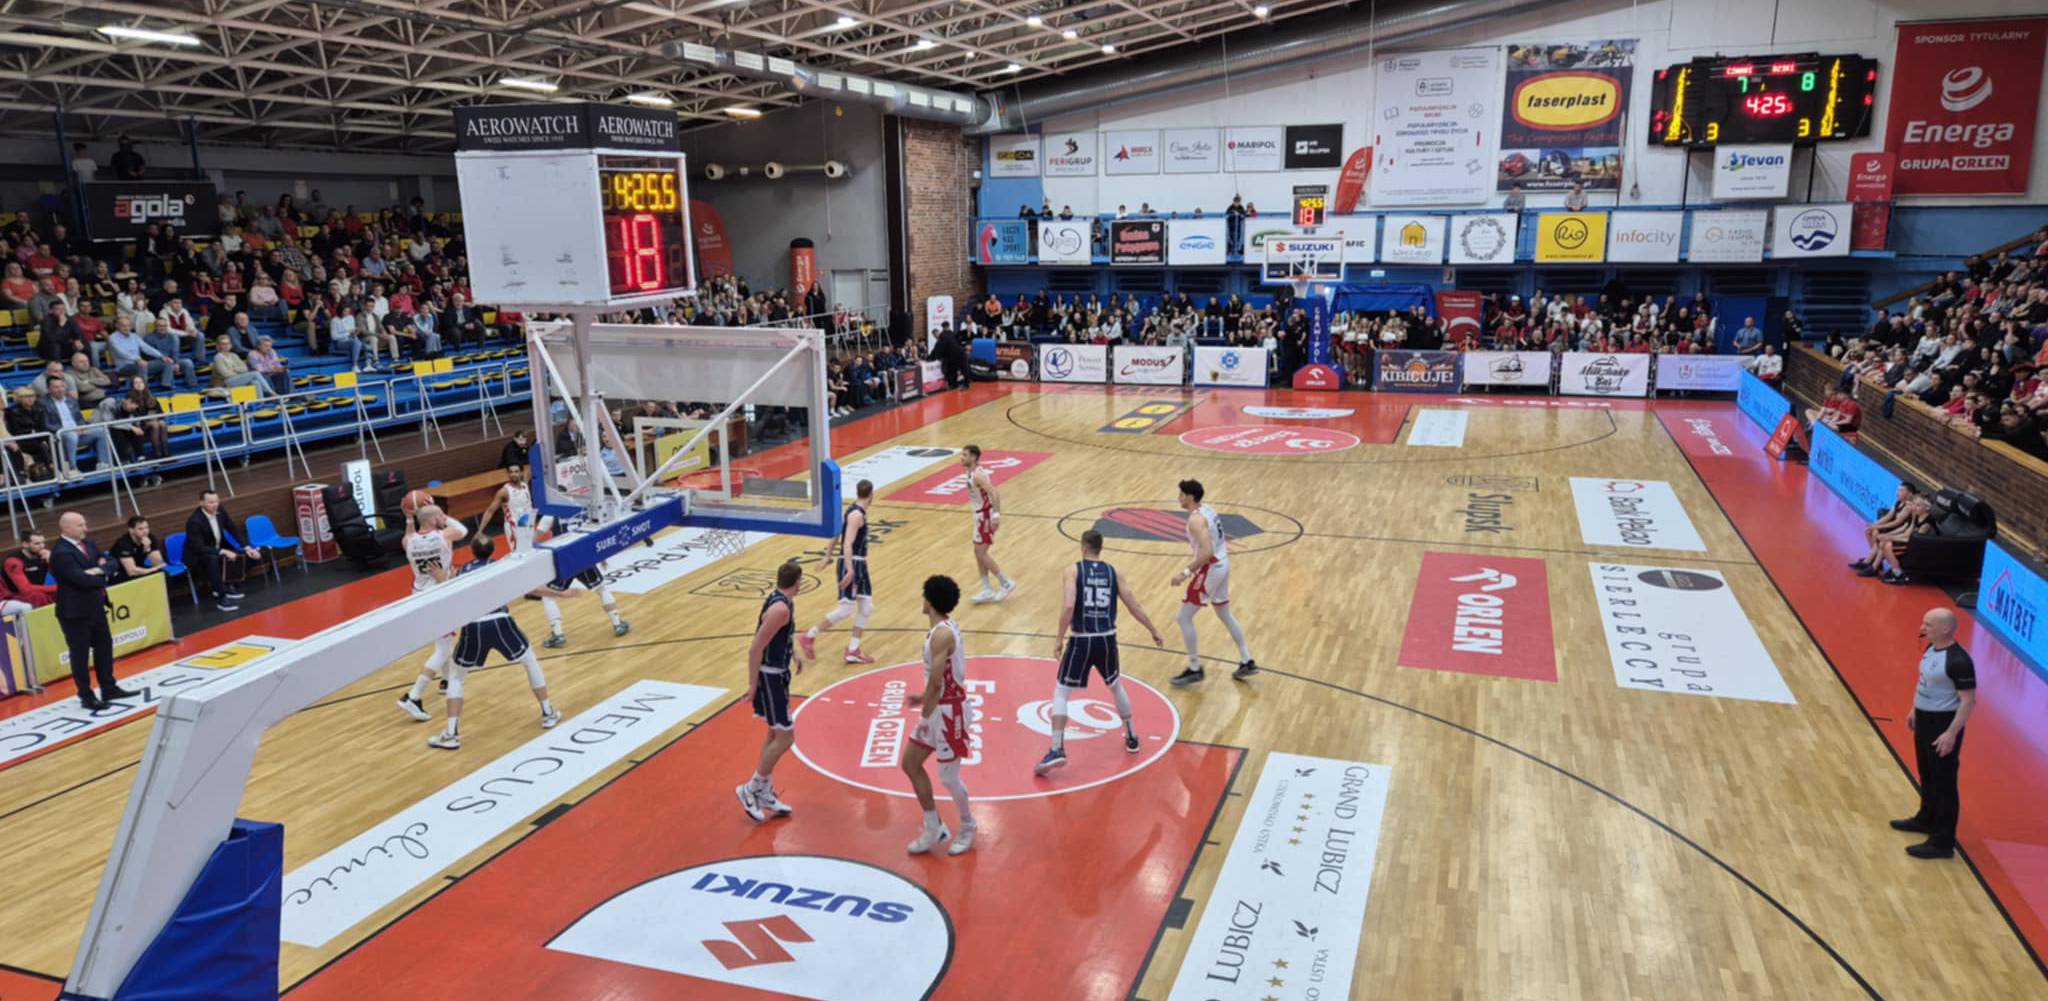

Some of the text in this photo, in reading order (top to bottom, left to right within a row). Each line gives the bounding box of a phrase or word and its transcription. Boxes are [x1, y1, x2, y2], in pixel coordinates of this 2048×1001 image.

[1915, 31, 2030, 44] SPONSOR TYTULARNY
[1737, 76, 1748, 93] 7
[1801, 71, 1815, 91] 8
[1527, 94, 1607, 108] faserplast
[466, 115, 580, 136] AEROWATCH
[598, 116, 673, 138] AEROWATCH
[1706, 122, 1719, 141] 3
[1797, 117, 1810, 137] 3
[1904, 120, 2015, 148] Energa
[1740, 154, 1784, 166] Tevan
[1901, 157, 2006, 170] GRUPA ORLEN
[114, 194, 184, 223] agola
[1289, 242, 1334, 251] SUZUKI
[1616, 228, 1676, 246] infocity
[620, 213, 662, 291] 18
[1131, 358, 1168, 367] MODUS
[1381, 370, 1454, 383] KIBICUJE!
[1608, 496, 1650, 519] Bank
[1616, 517, 1658, 545] Pekao
[595, 534, 617, 552] SURE
[1084, 587, 1110, 607] 15
[1452, 593, 1504, 655] ORLEN
[1995, 585, 2036, 642] MATBET
[1600, 565, 1664, 688] SIERLECCY
[1658, 632, 1713, 692] grupa
[867, 680, 907, 764] GRUPA ORLEN
[284, 691, 677, 905] MEDICUS clinic
[1314, 766, 1370, 895] GRAND LUBICZ
[692, 872, 914, 923] SUZUKI
[1205, 900, 1263, 985] LUBICZ
